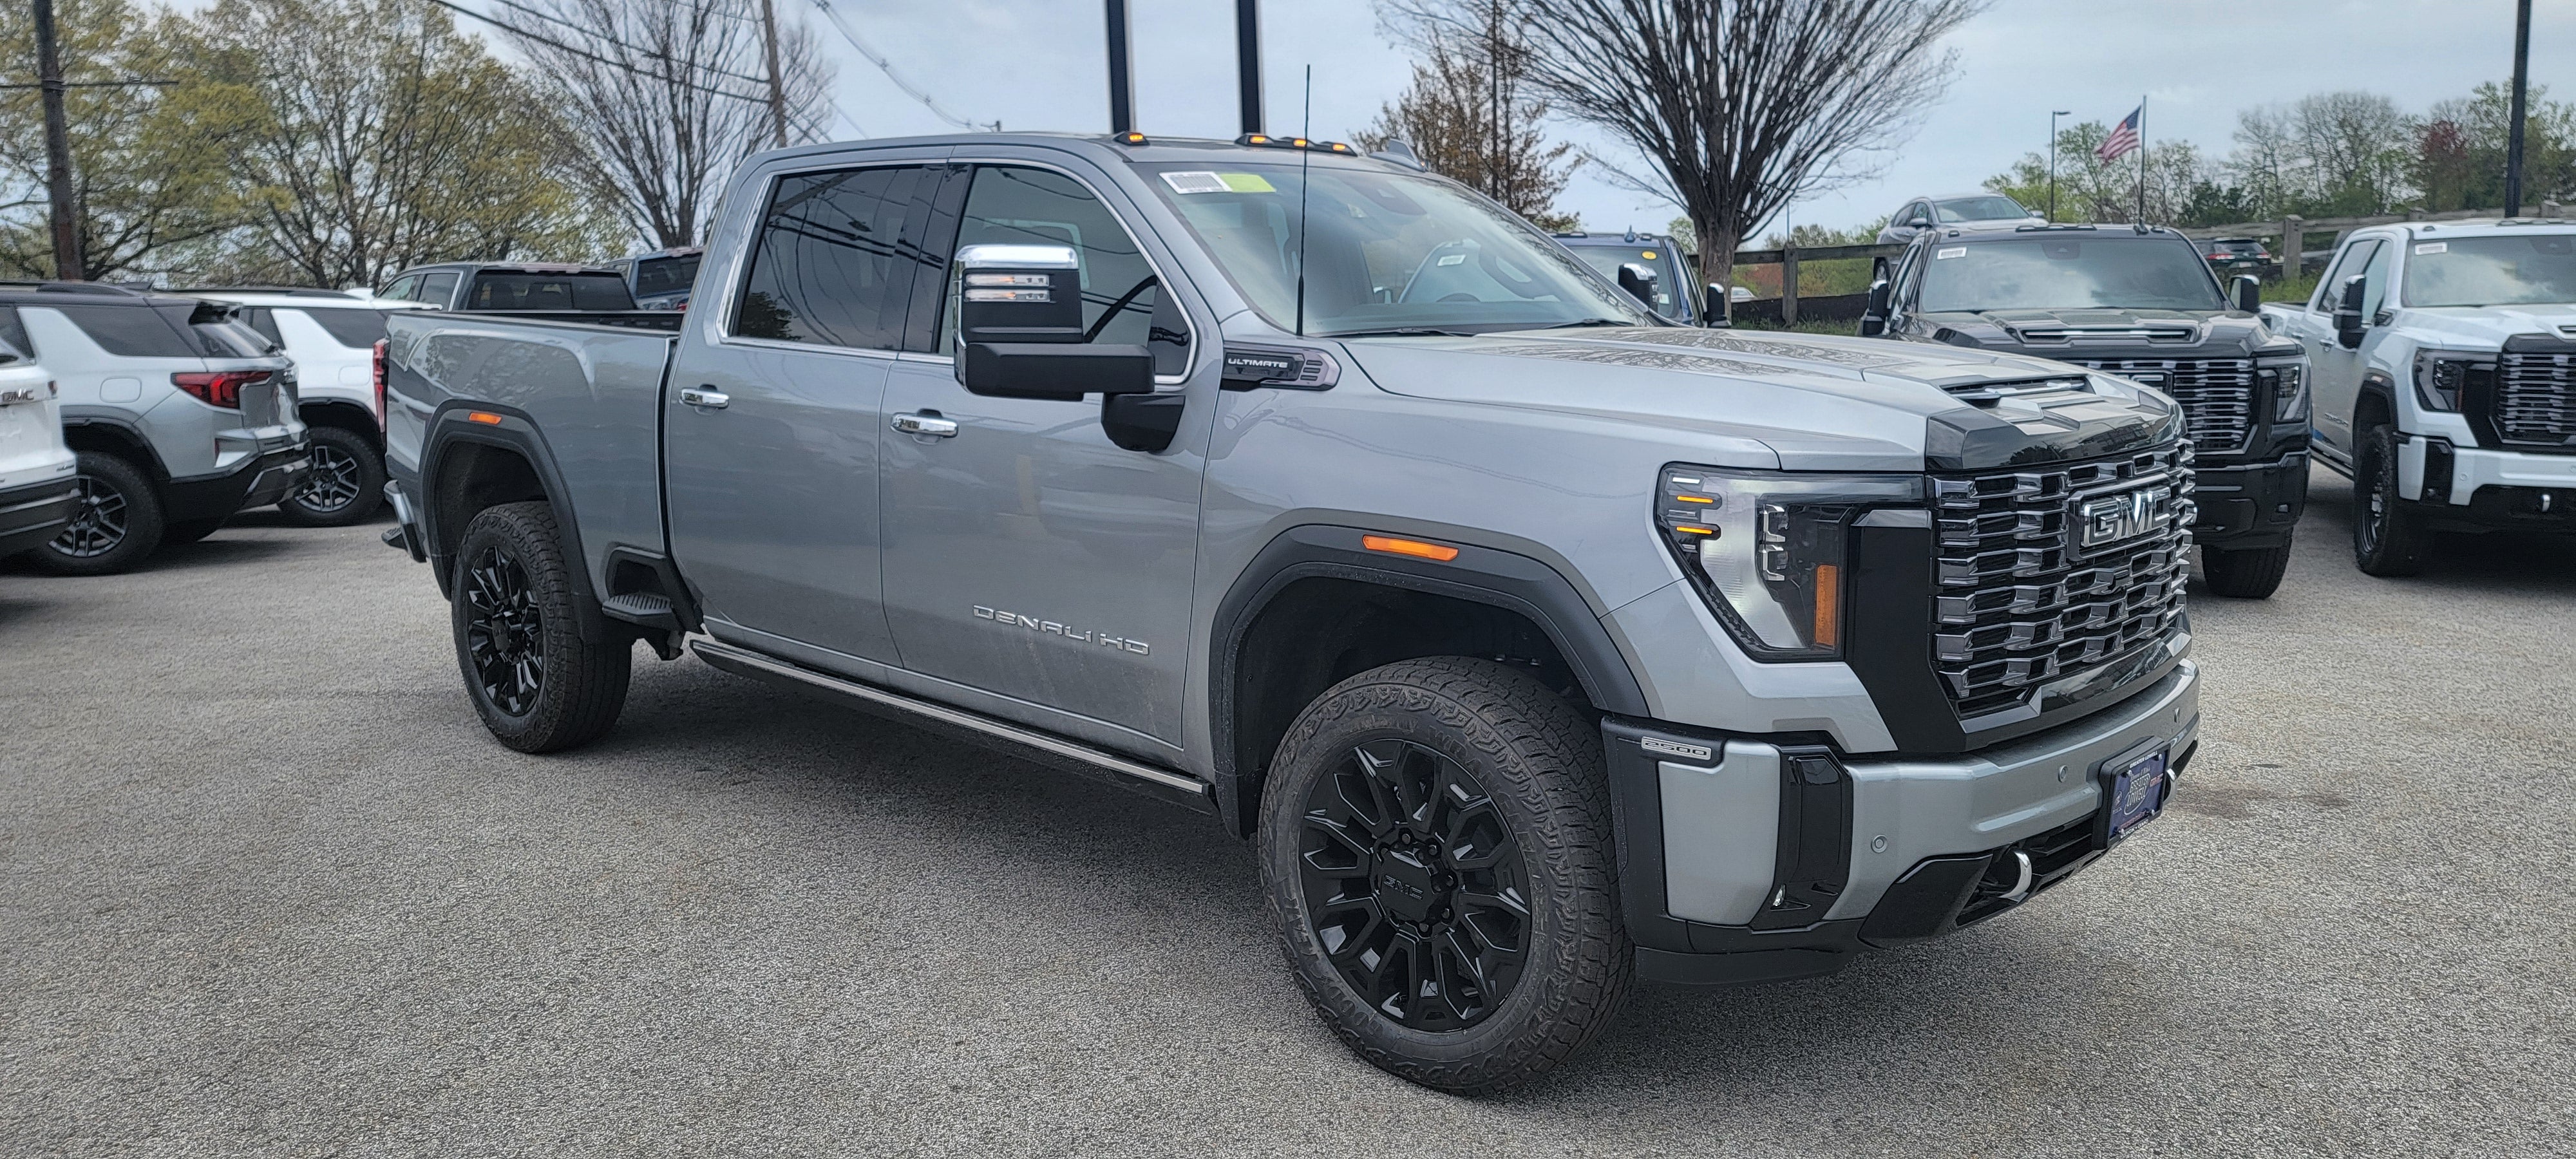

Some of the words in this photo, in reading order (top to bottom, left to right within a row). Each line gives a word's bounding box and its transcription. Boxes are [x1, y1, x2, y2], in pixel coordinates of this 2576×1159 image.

[1227, 357, 1289, 368] ULTIMATE
[2081, 486, 2171, 547] GMC
[973, 604, 1093, 643] DENALI
[1099, 633, 1150, 655] HD
[1644, 740, 1708, 757] 2500
[2129, 757, 2145, 769] GREATER
[2145, 750, 2158, 761] LOWELL
[1383, 874, 1424, 901] GMC
